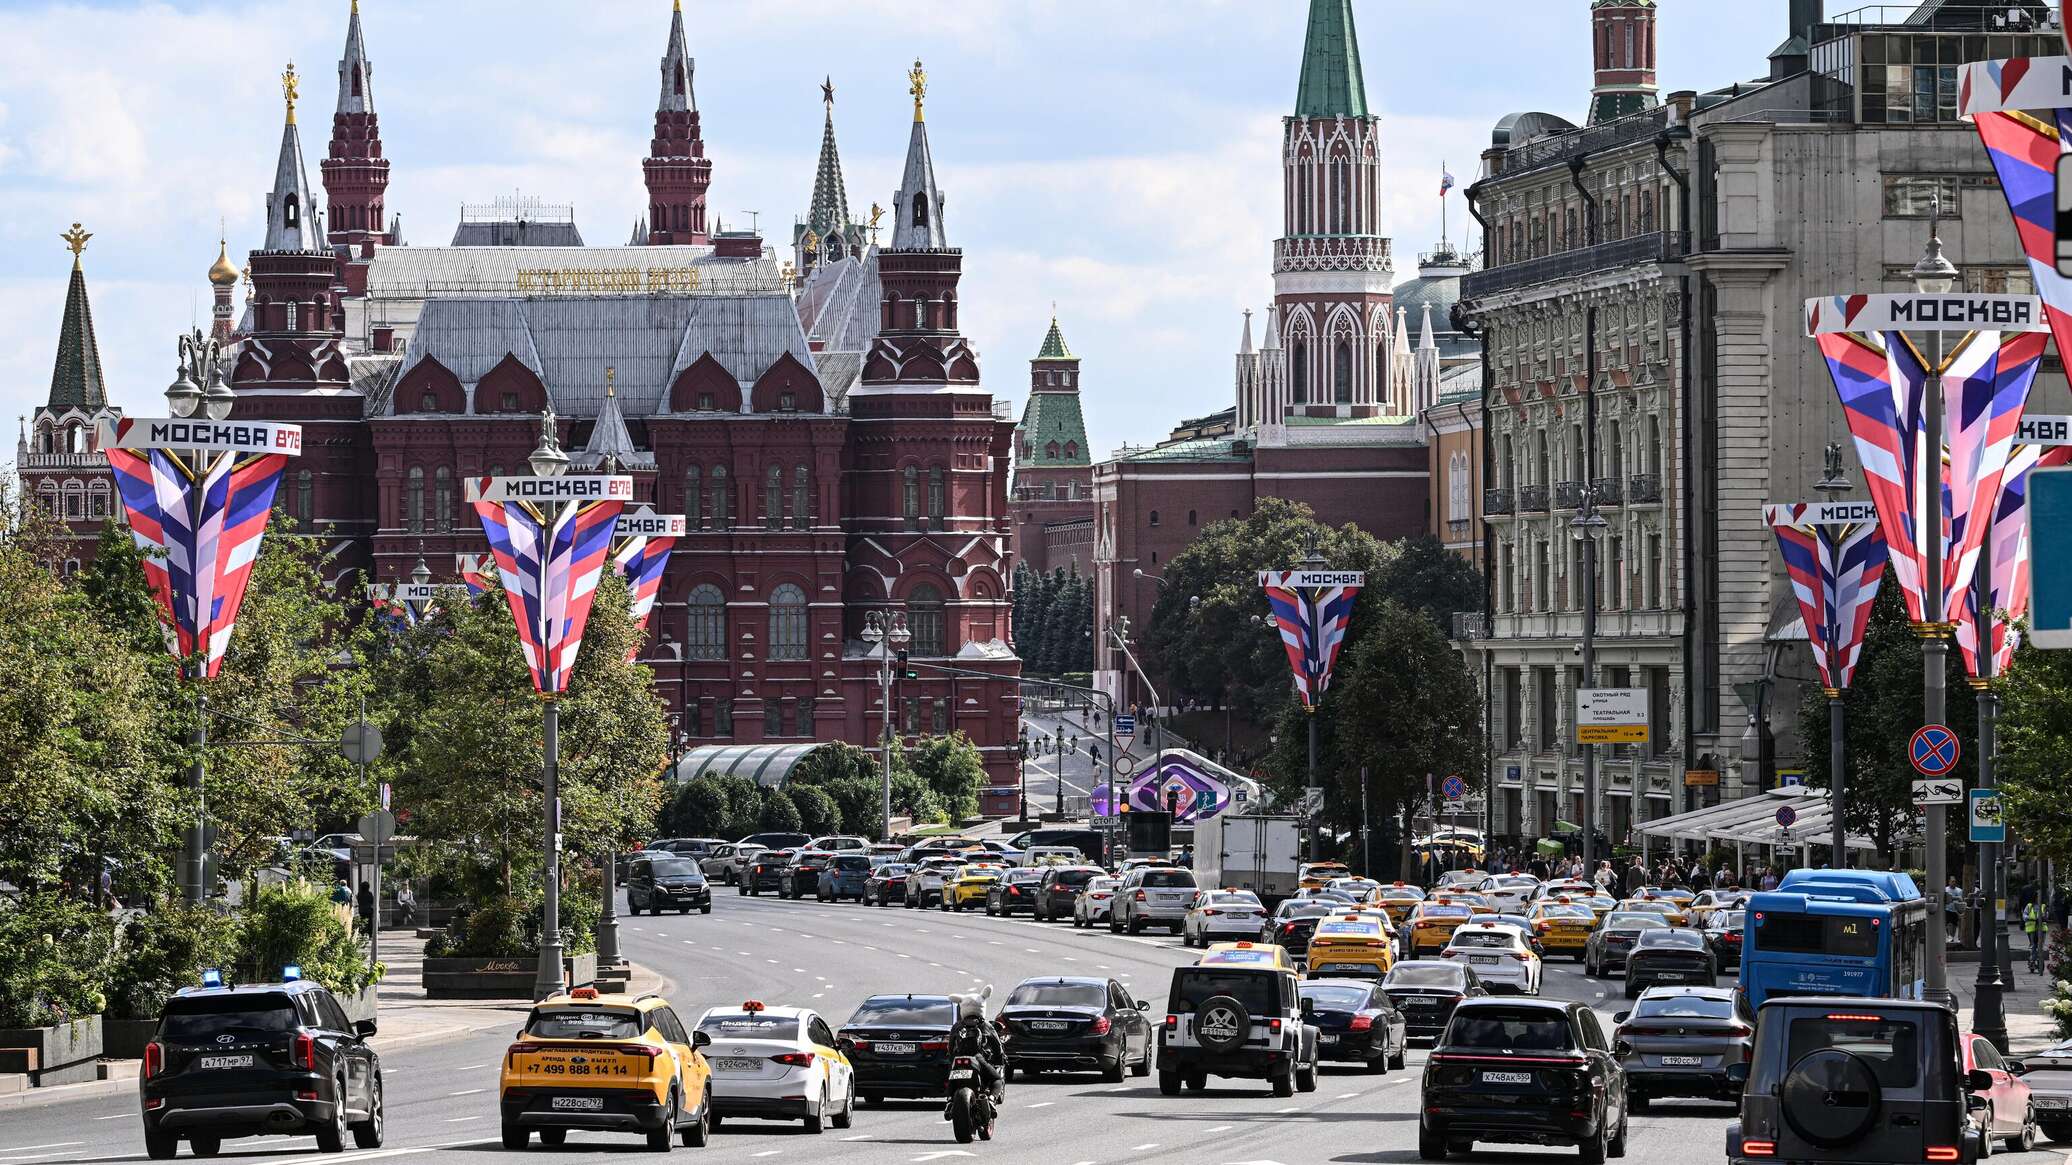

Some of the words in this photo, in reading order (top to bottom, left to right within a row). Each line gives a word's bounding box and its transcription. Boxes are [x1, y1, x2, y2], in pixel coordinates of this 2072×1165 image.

[1891, 300, 2030, 324] МОСКВА
[151, 424, 268, 446] МОСКВА
[506, 480, 601, 496] МОСКВА
[608, 480, 631, 495] 878
[1301, 574, 1356, 584] МОСКВА
[205, 1057, 239, 1067] А717МР
[240, 1055, 251, 1063] 97
[528, 1064, 540, 1073] +7
[544, 1065, 565, 1074] 499
[569, 1065, 590, 1075] 888
[595, 1065, 609, 1075] 14
[614, 1065, 627, 1075] 14
[1485, 1073, 1516, 1082] Х748АК
[554, 1098, 587, 1107] Н228ОЕ
